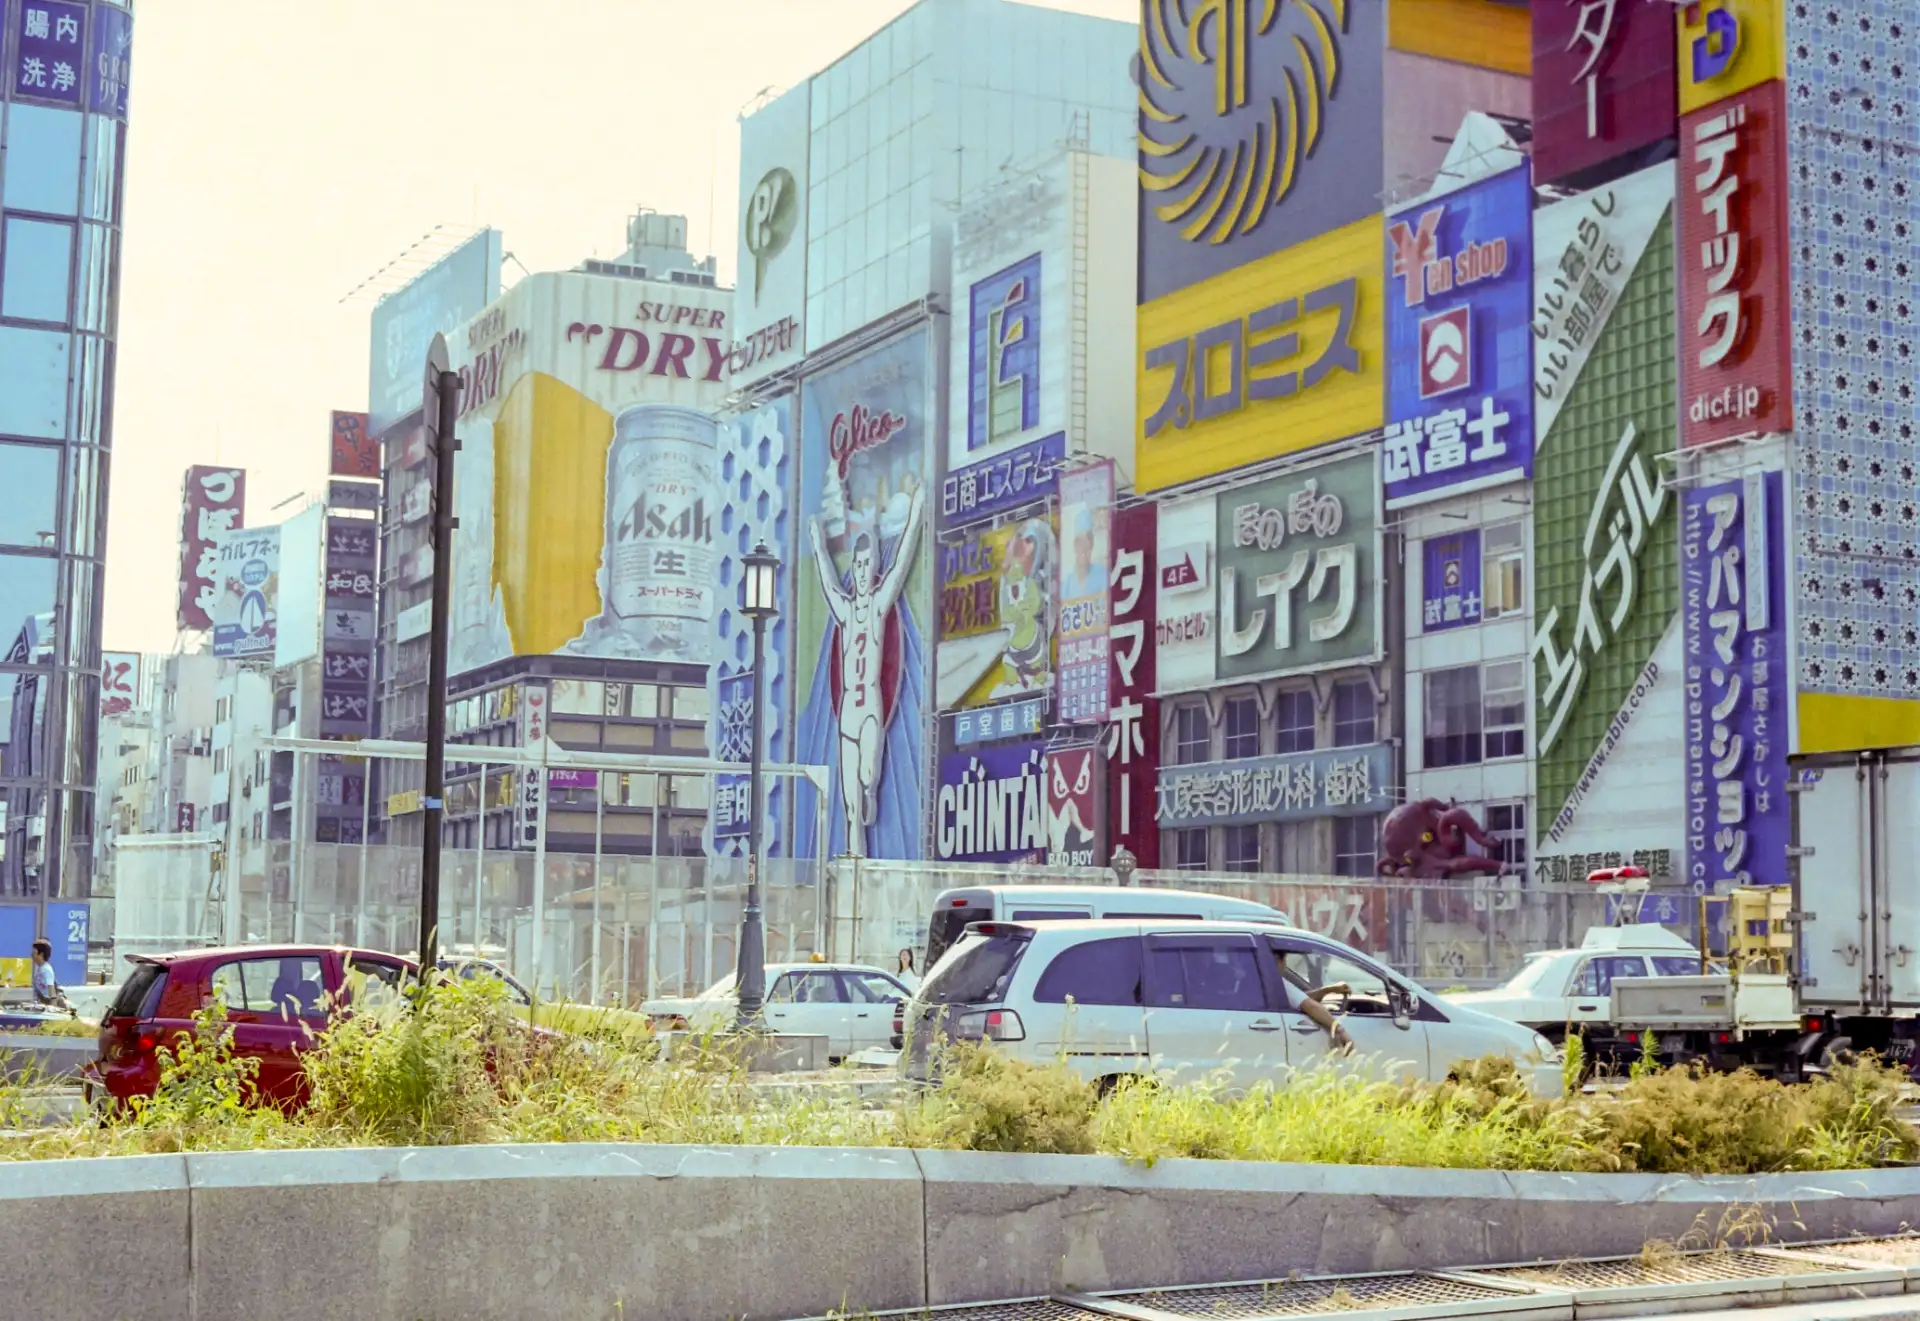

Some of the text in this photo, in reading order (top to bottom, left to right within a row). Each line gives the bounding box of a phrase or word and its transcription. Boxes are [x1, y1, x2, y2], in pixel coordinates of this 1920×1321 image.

[25, 9, 79, 44] 腸内
[21, 57, 77, 91] 洗浄
[1694, 105, 1746, 371] ディック
[1456, 238, 1507, 285] shop
[1529, 190, 1617, 341] いい暮らし
[636, 301, 727, 330] SUPER
[1534, 243, 1624, 401] いい部屋で
[1143, 276, 1362, 438] プロミス
[1690, 384, 1760, 424] dicf.jp
[830, 403, 905, 481] Glico
[1384, 397, 1510, 484] 武富士
[1233, 478, 1344, 550] ほのぼの
[653, 550, 687, 576] 生
[1166, 566, 1188, 586] 4F
[327, 573, 372, 594] 和民
[637, 585, 704, 602] スーパードライ
[1221, 542, 1358, 658] レイク
[1530, 420, 1667, 760] エイブル
[1424, 592, 1481, 626] 武富士
[1156, 611, 1213, 647] カドのビル
[325, 655, 368, 678] はや
[854, 626, 868, 708] グリコ
[323, 695, 367, 718] はや
[958, 704, 1043, 739] 戸室歯科
[1547, 660, 1661, 845] http://www.able.co.jp
[1049, 852, 1069, 867] BAD
[1071, 850, 1093, 866] BOY
[67, 920, 87, 942] 24
